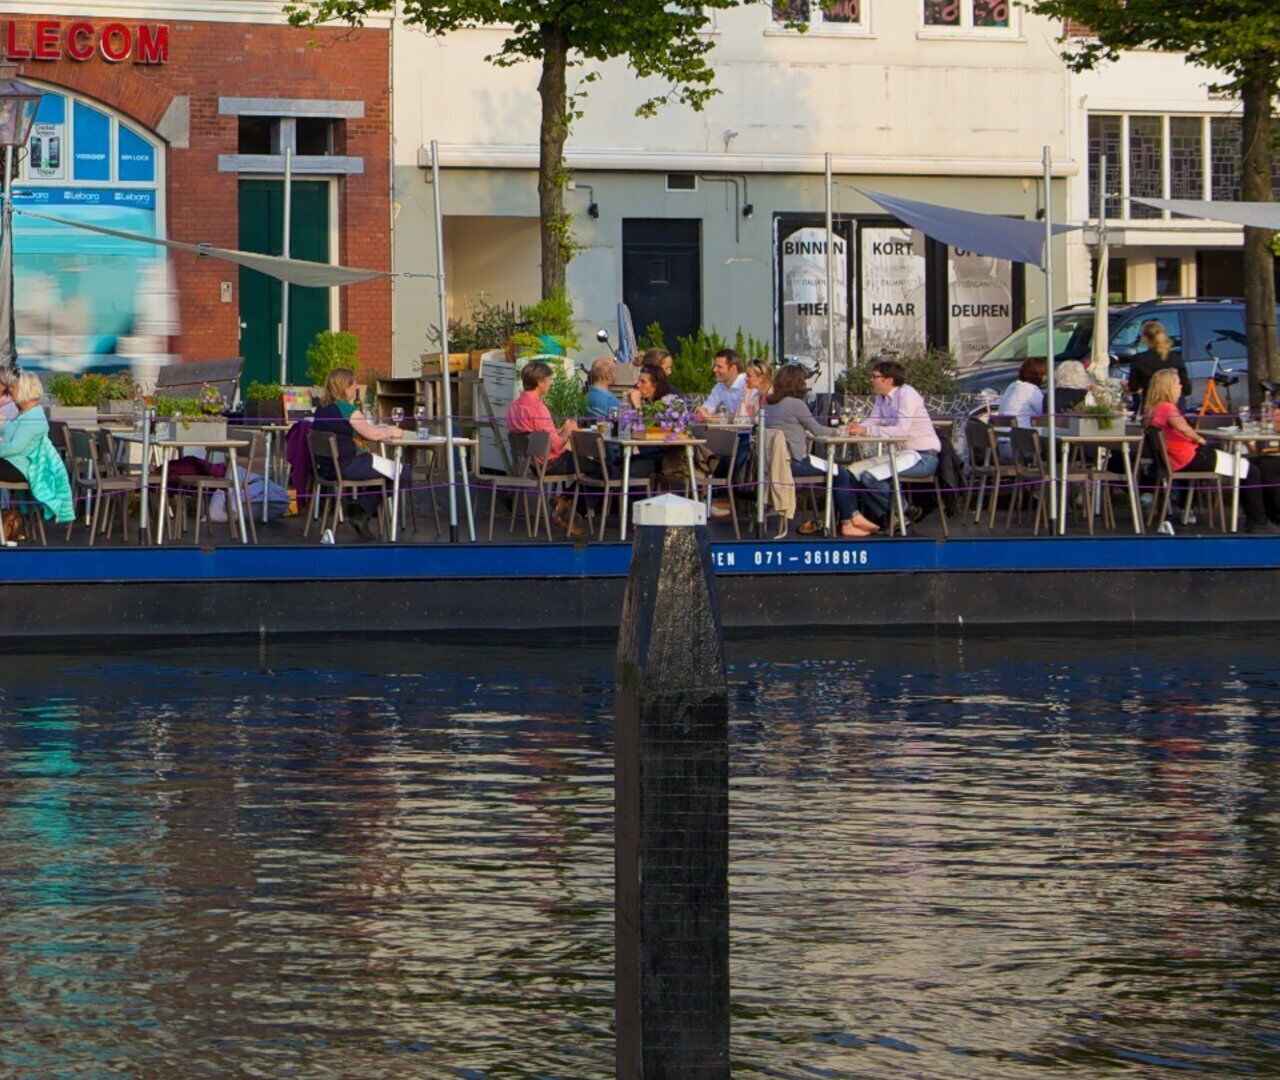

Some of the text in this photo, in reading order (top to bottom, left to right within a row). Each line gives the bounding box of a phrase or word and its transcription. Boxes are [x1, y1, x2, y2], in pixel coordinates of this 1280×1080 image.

[71, 192, 100, 201] Lebara
[121, 192, 150, 201] Lebara
[873, 242, 913, 255] KORT
[872, 303, 915, 316] HAAR
[951, 303, 1009, 317] DEUREN
